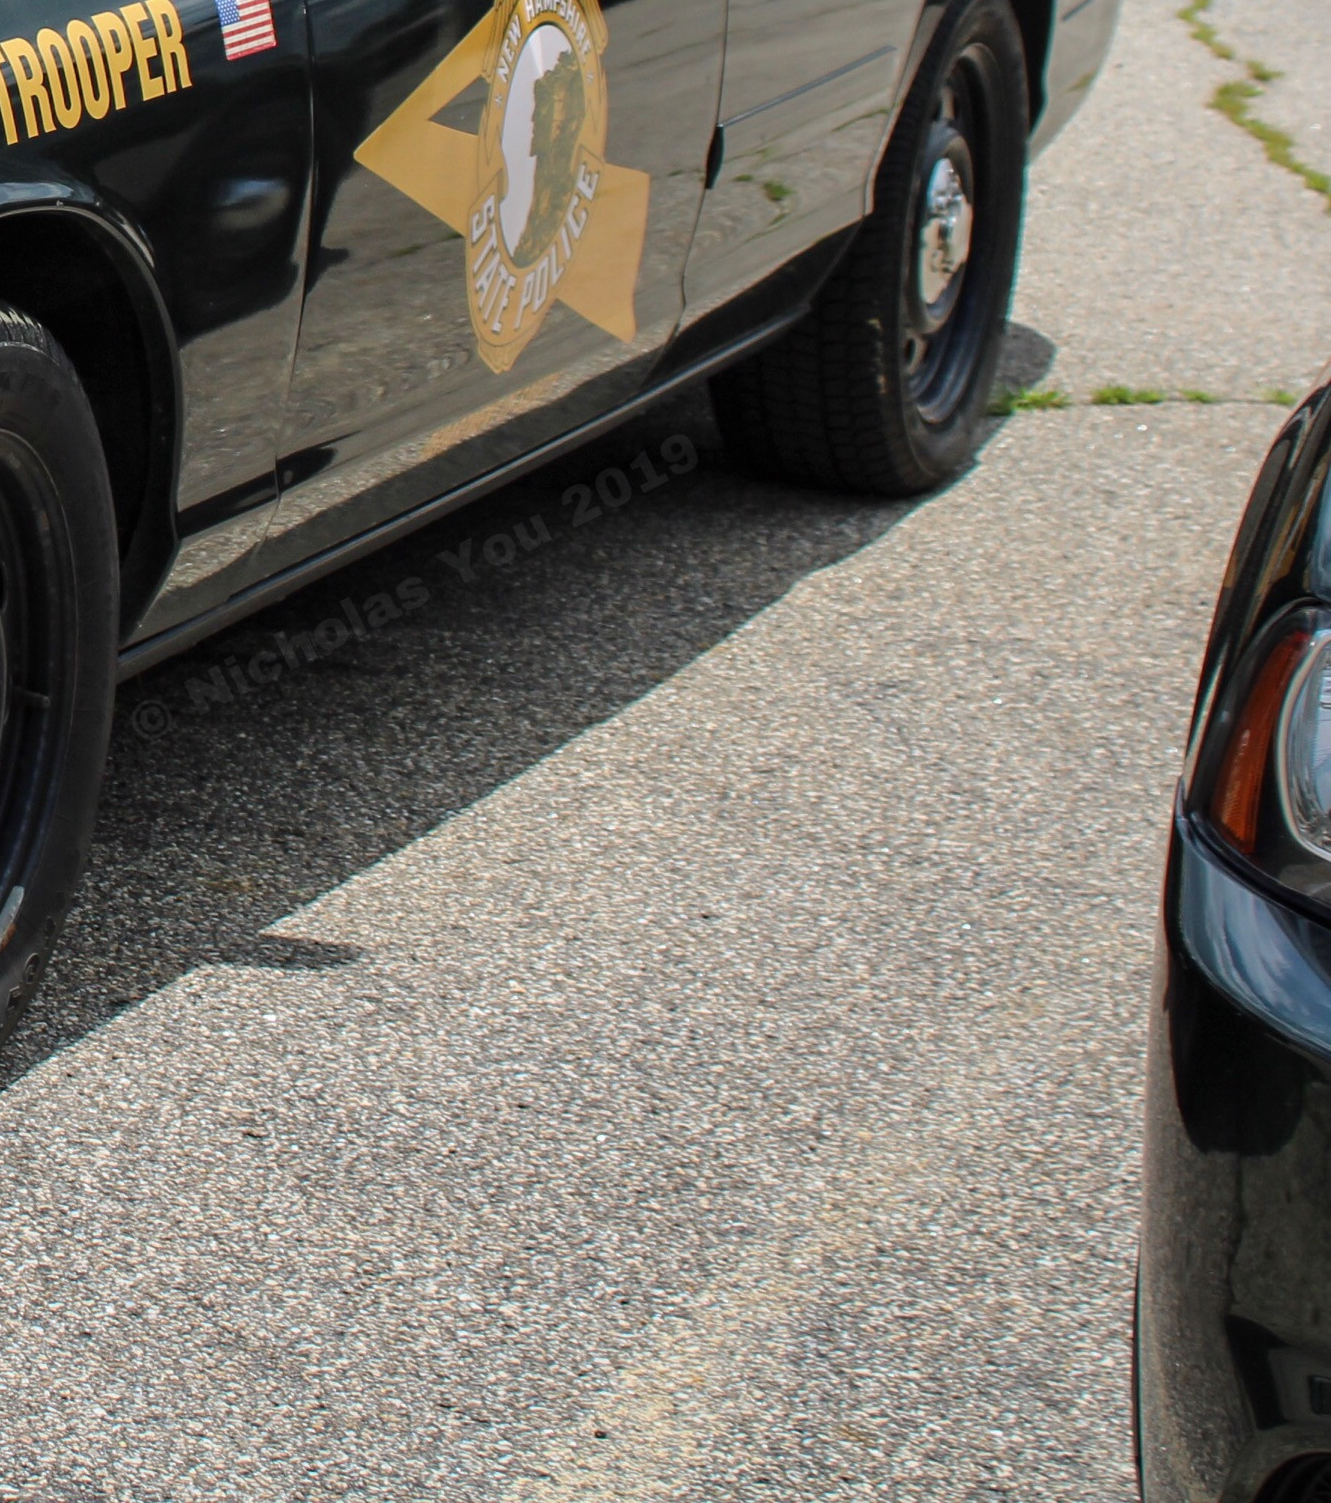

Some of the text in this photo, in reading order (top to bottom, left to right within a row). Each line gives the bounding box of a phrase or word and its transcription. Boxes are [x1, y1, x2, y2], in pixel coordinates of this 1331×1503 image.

[496, 14, 522, 83] NEW
[471, 163, 601, 334] STATE POLICE
